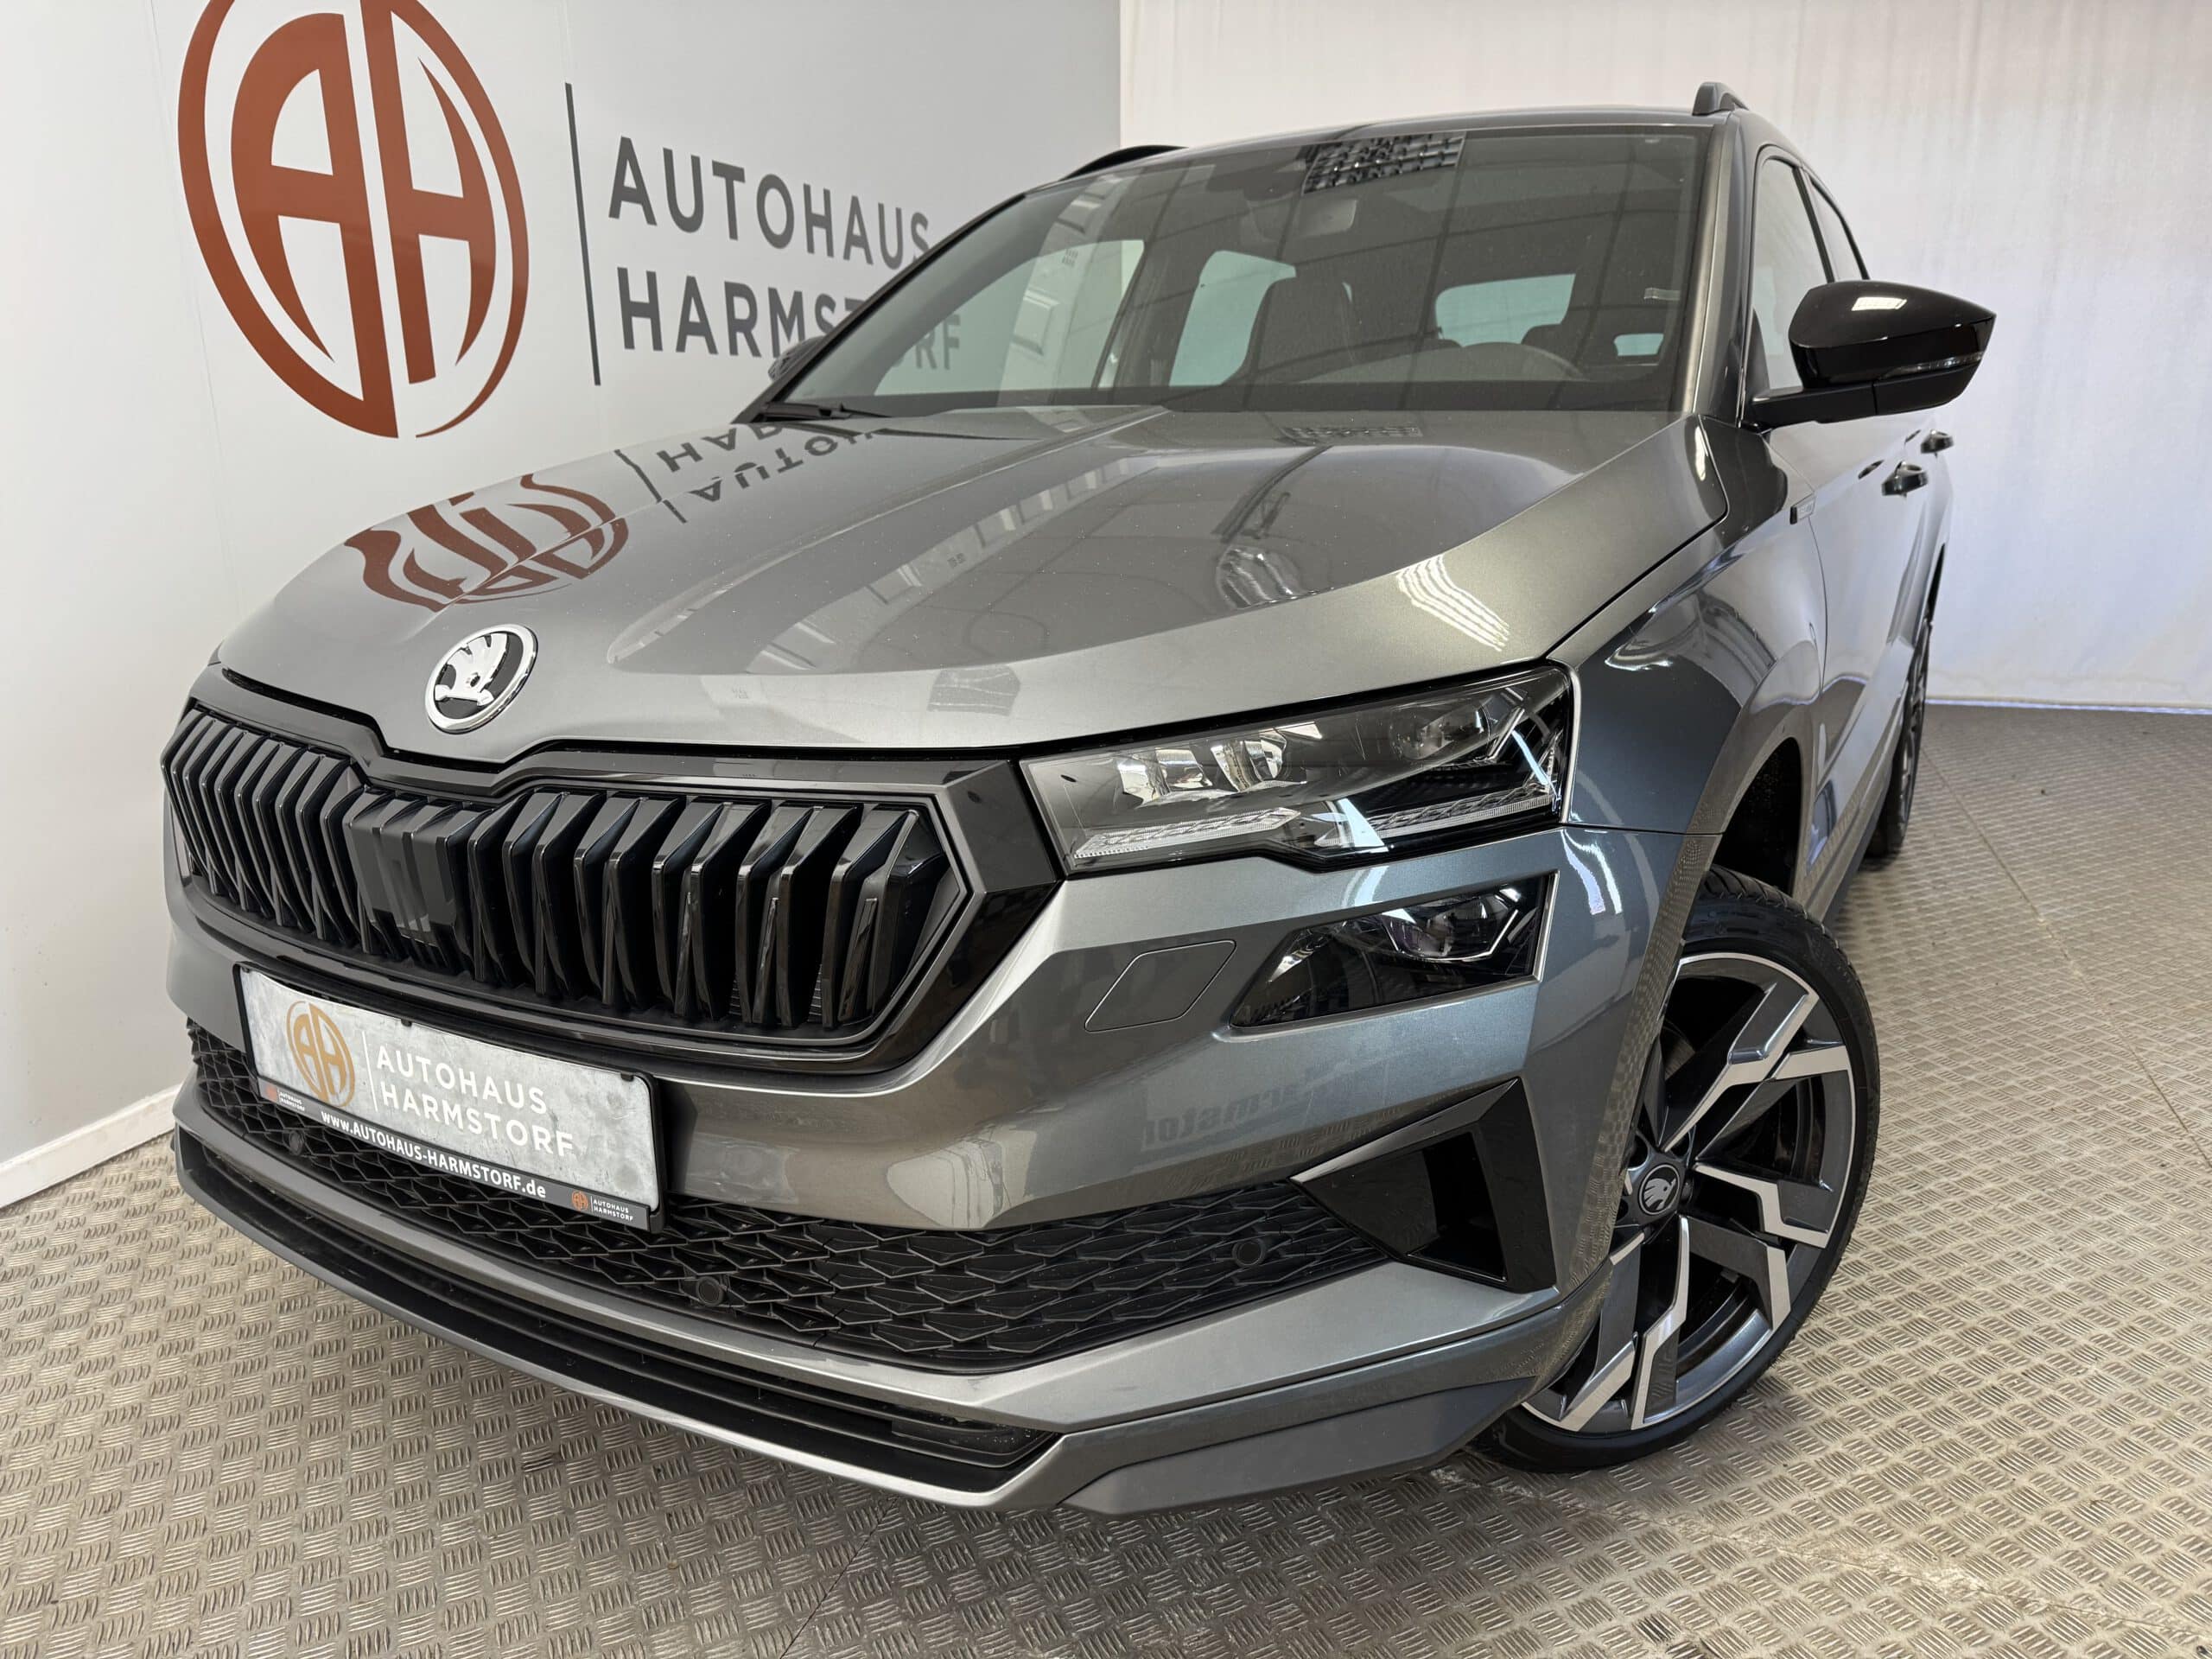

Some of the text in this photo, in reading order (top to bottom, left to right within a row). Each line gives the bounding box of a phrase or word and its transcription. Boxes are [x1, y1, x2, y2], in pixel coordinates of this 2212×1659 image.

[607, 135, 931, 270] AUTOHAUS
[376, 1045, 548, 1115] AUTOHAUS
[320, 1110, 547, 1199] www.AUTOHAUS-HARMSTORF.de
[379, 1081, 575, 1158] HARMSTORF
[593, 1198, 629, 1213] AUTOHAUS
[594, 1205, 634, 1222] HARMSTORF
